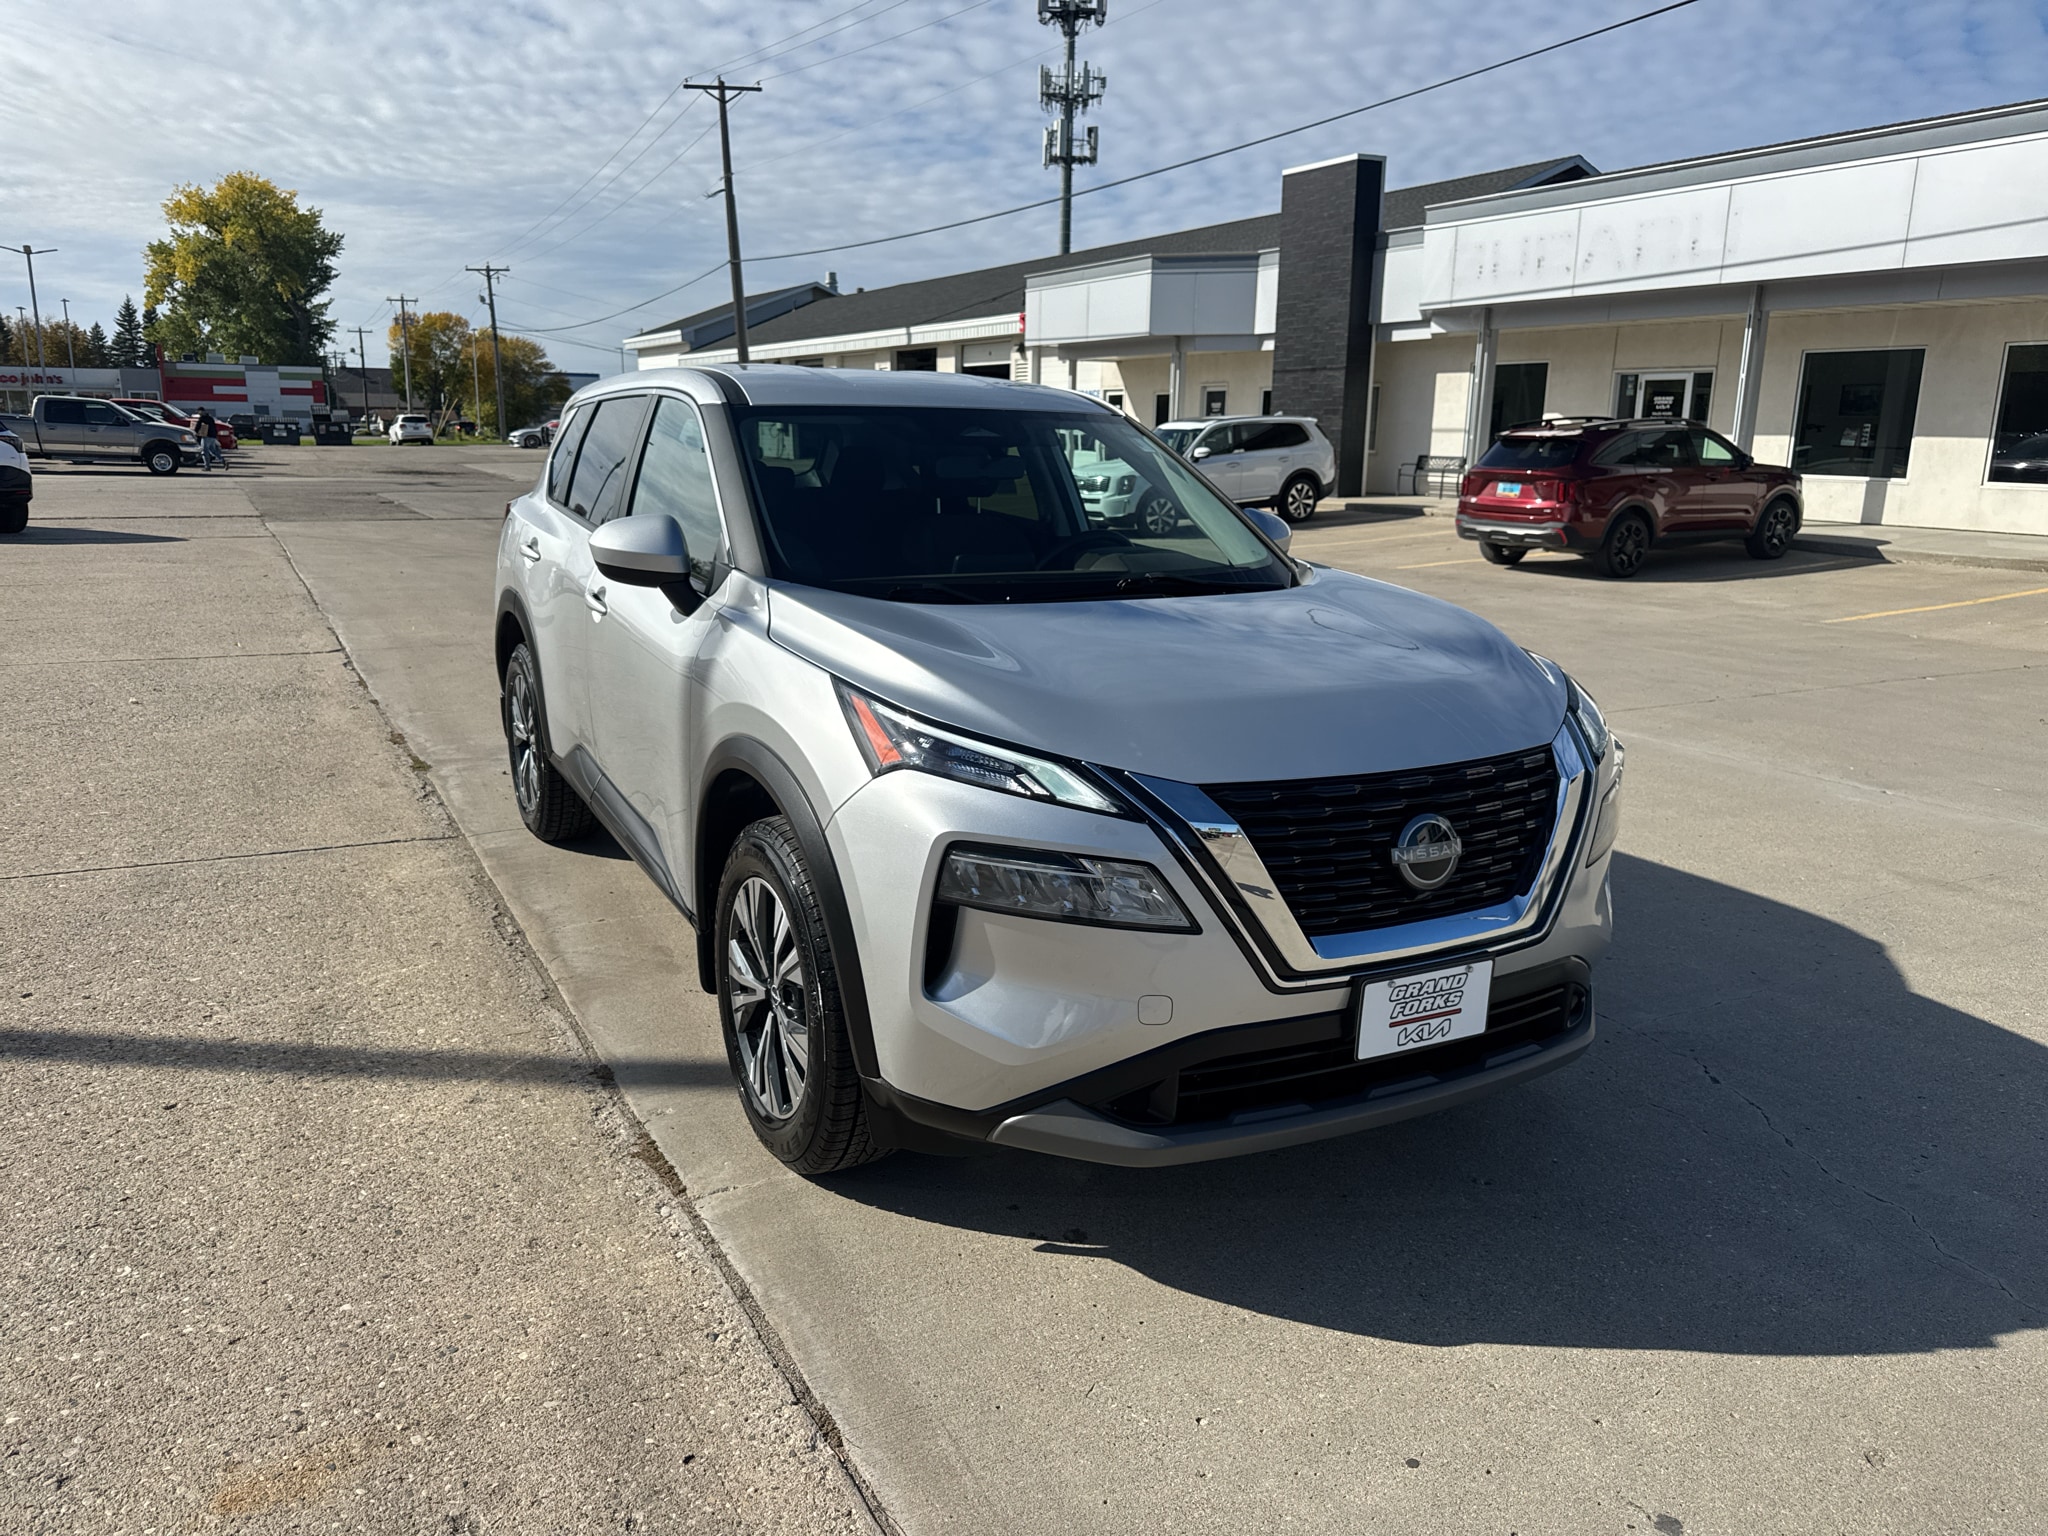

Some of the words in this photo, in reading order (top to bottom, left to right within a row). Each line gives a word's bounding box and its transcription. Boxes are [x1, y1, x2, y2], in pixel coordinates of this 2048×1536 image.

[1393, 838, 1461, 861] NISSAN
[1388, 972, 1469, 1003] GRAND
[1389, 990, 1464, 1019] FORKS
